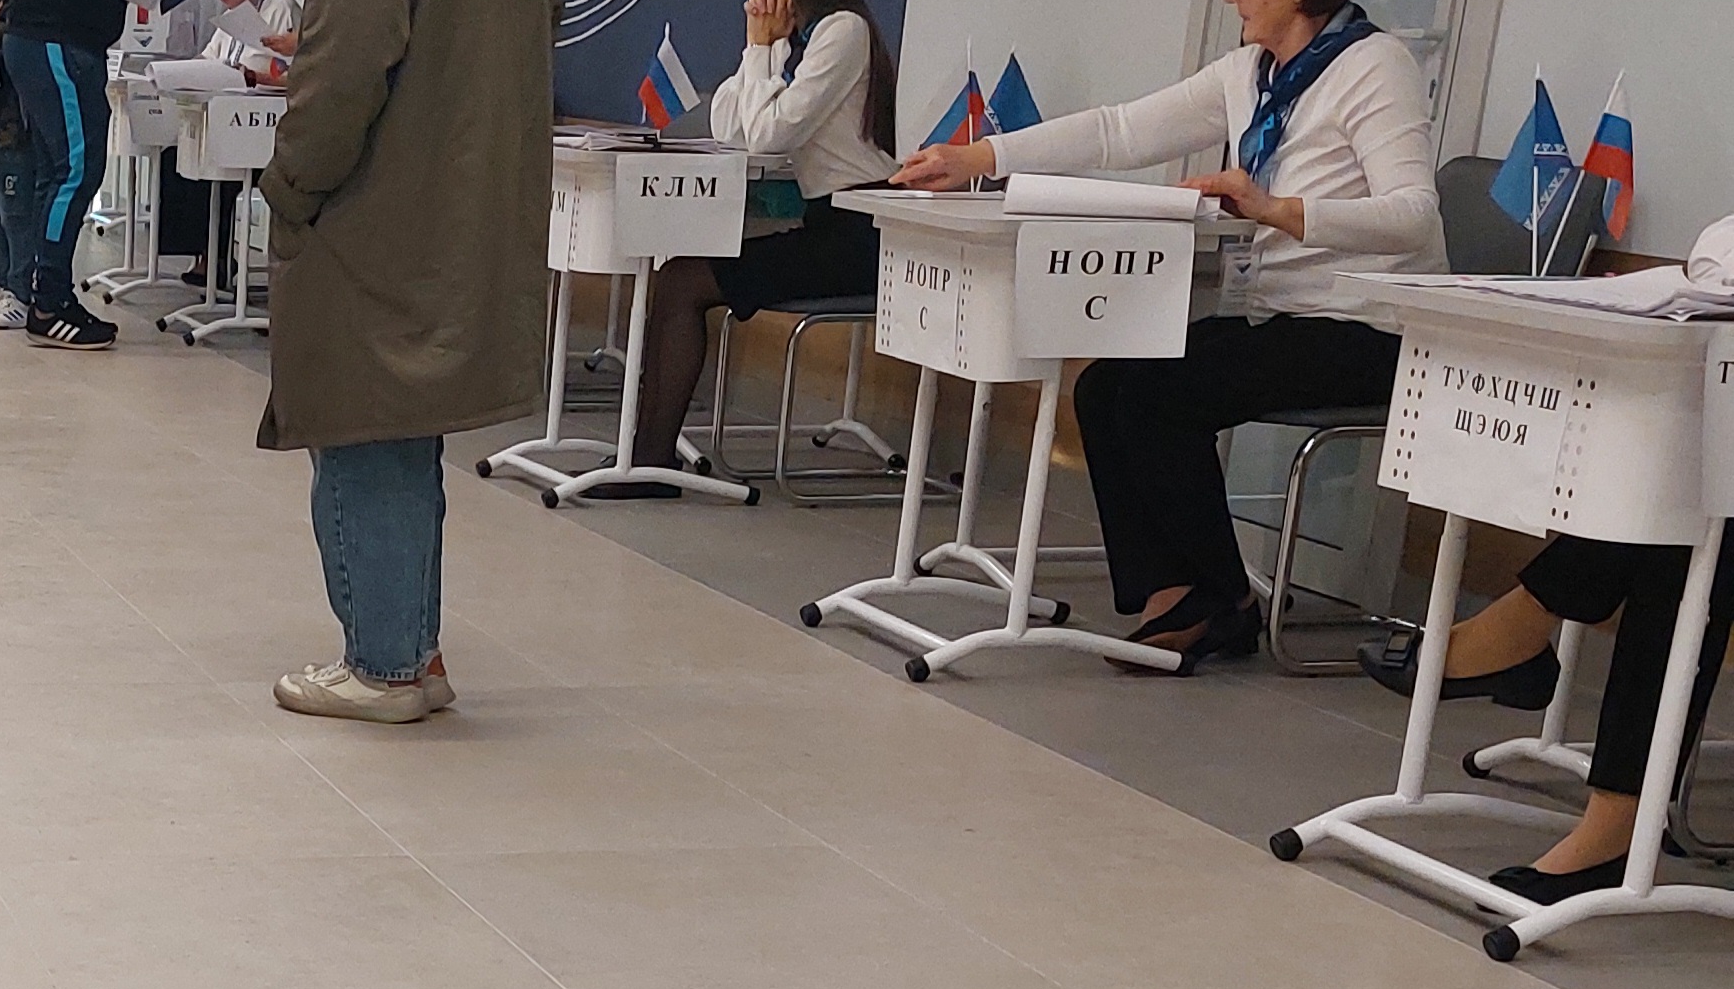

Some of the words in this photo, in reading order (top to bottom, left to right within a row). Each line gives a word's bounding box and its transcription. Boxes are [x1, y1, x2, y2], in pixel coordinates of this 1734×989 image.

[905, 259, 951, 292] НОПР
[919, 305, 928, 331] С
[1085, 295, 1108, 320] С
[1443, 365, 1562, 412] ТУФХЦЧШ
[1454, 407, 1528, 446] ЩЭЮЯ
